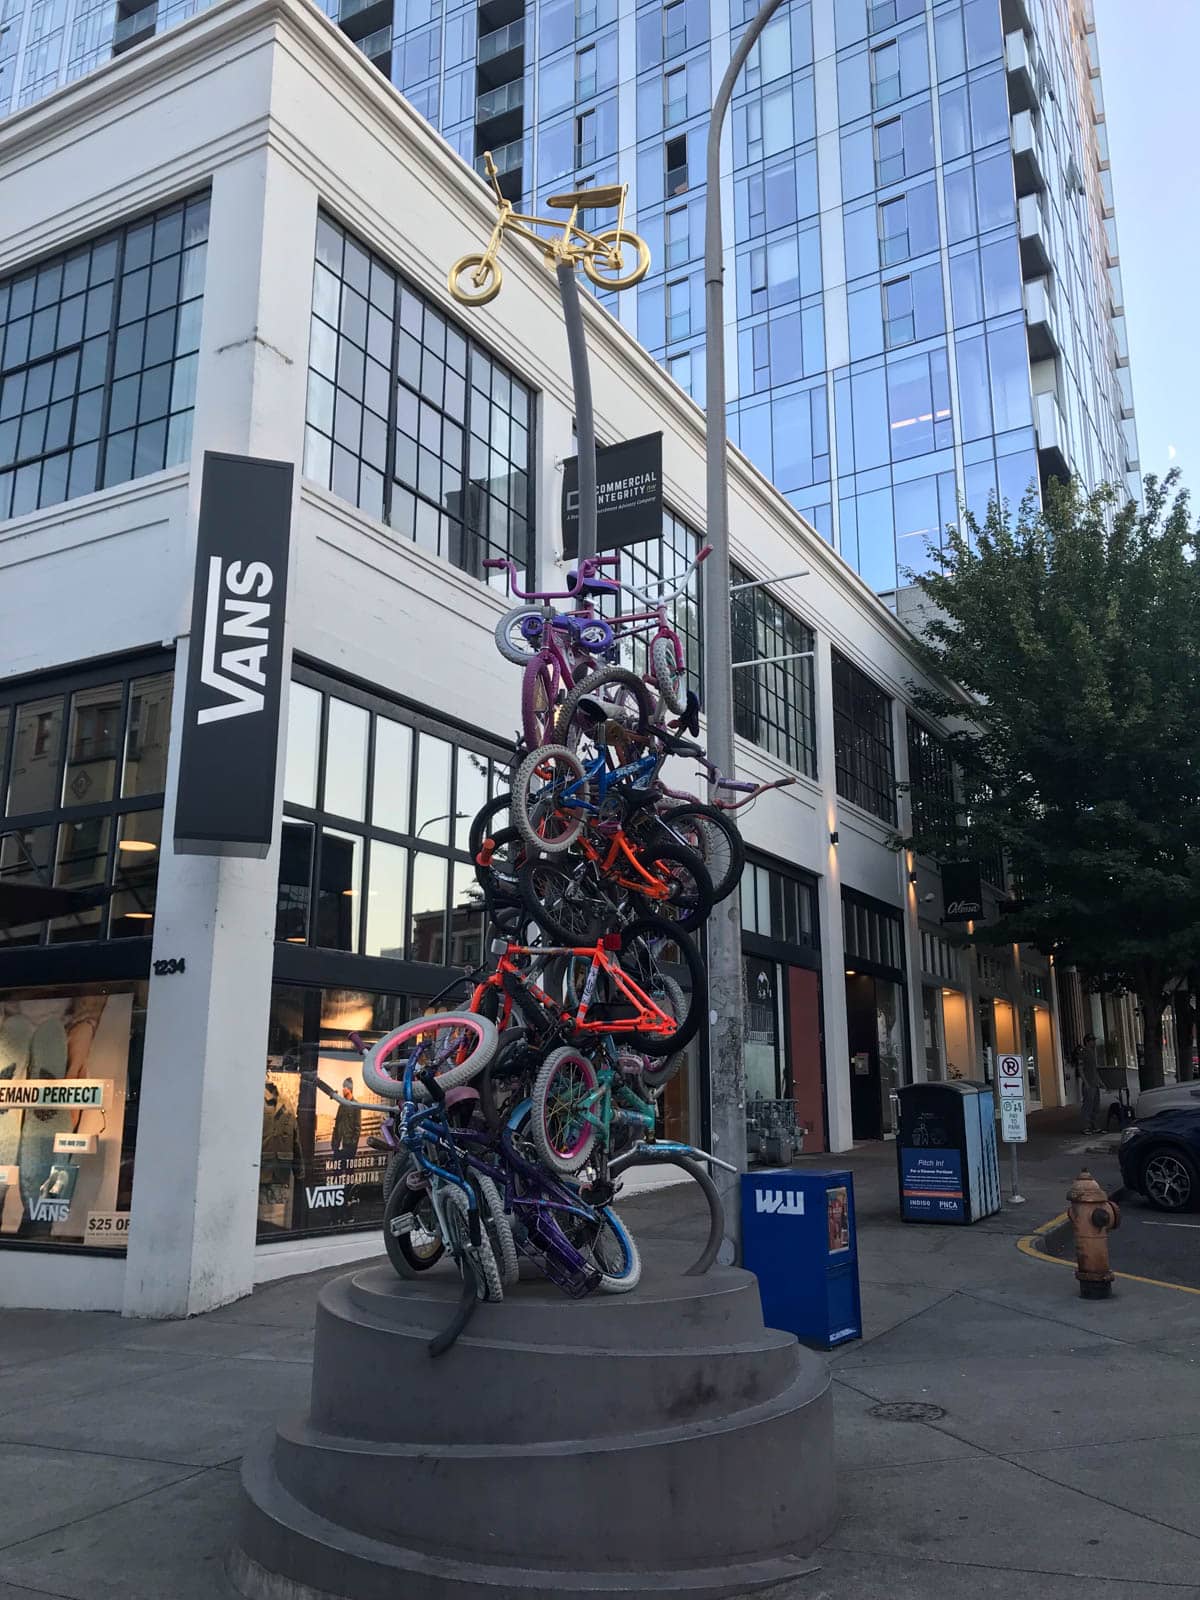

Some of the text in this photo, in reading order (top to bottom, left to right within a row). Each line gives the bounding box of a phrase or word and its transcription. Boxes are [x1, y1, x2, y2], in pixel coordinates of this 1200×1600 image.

[596, 472, 656, 495] COMMERCIAL
[598, 485, 646, 505] NTEGRITY
[197, 556, 274, 725] VANS
[153, 958, 186, 976] 1234
[43, 1087, 99, 1104] PERFECT
[326, 1160, 342, 1170] MADE
[346, 1158, 374, 1168] TOUGHER
[327, 1172, 379, 1185] SKATEBOARDING
[305, 1184, 345, 1209] VANS
[29, 1198, 69, 1222] VANS
[88, 1218, 112, 1231] $25
